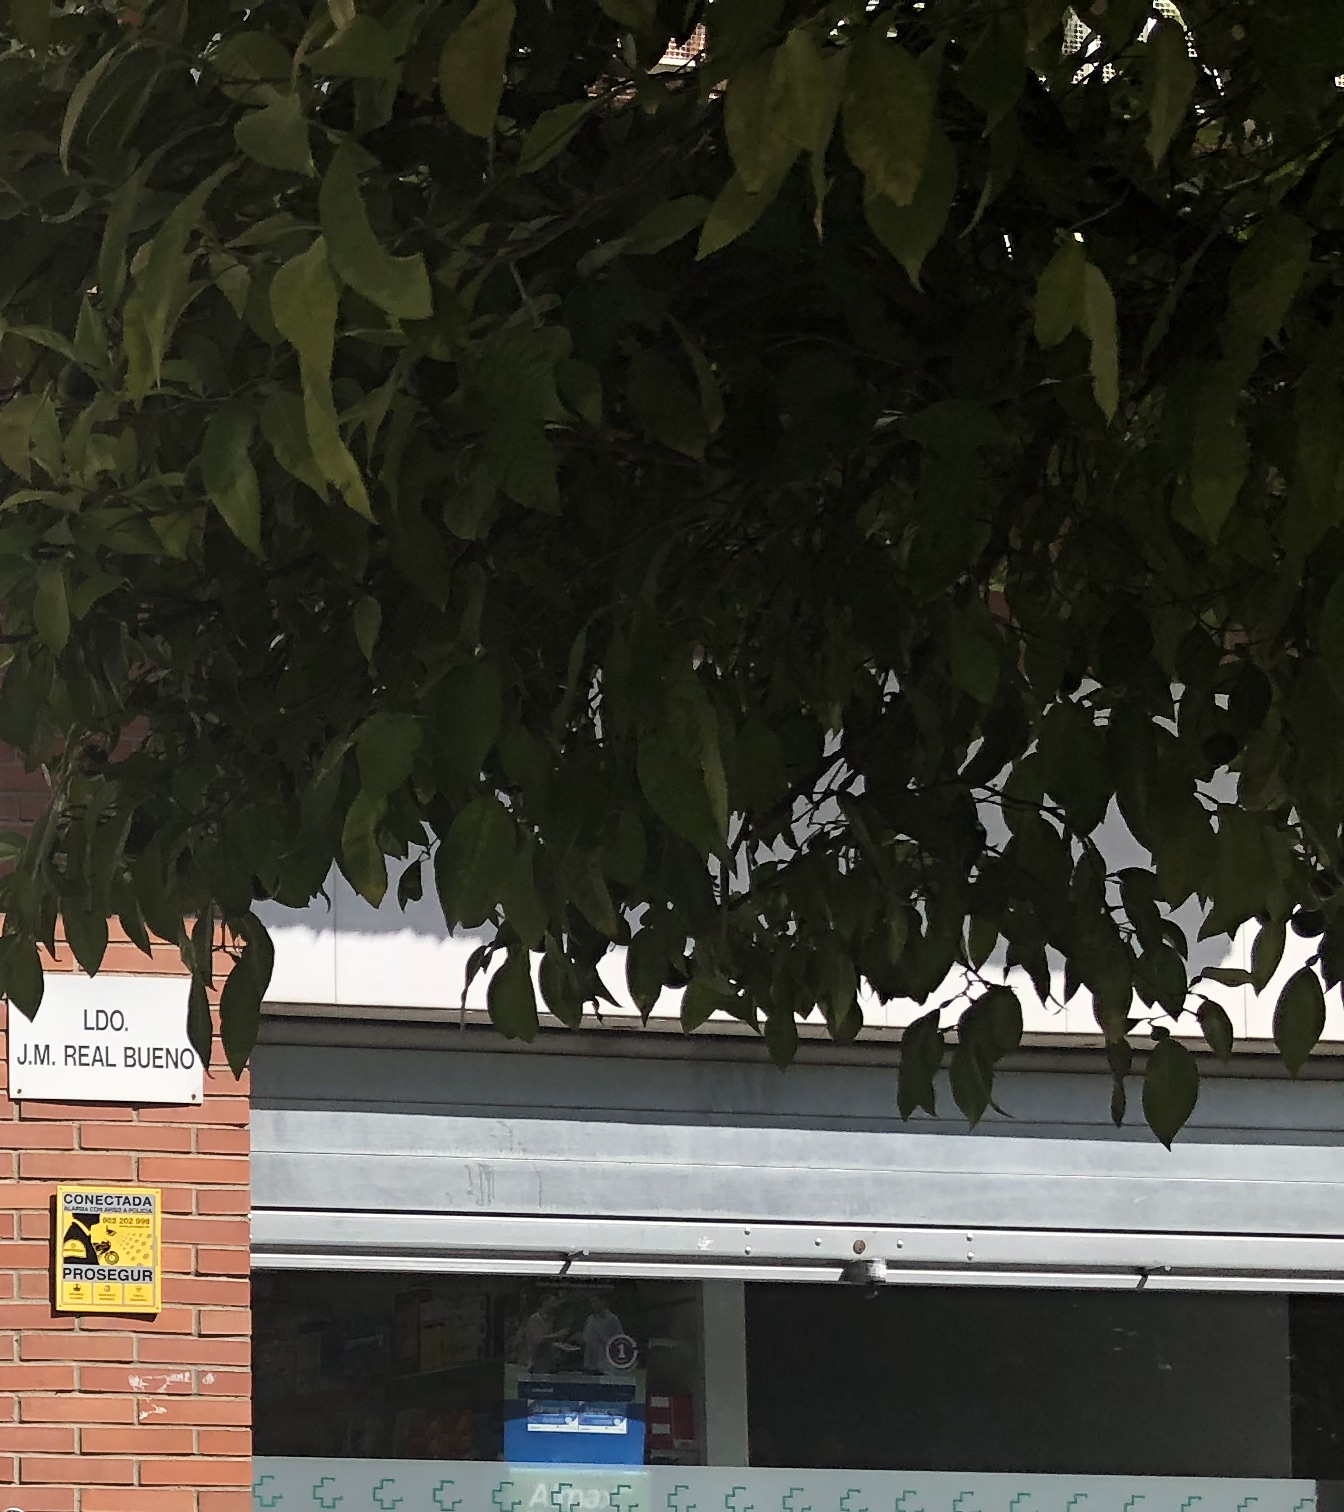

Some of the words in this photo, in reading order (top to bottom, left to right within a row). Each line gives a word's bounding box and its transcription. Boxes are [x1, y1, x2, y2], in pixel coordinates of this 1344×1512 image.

[83, 1009, 129, 1033] LDO.
[17, 1044, 56, 1067] J.M.
[64, 1045, 117, 1068] REAL
[124, 1047, 195, 1070] BUENO
[63, 1193, 152, 1207] CONECTADA
[63, 1268, 153, 1282] PROSEGUR
